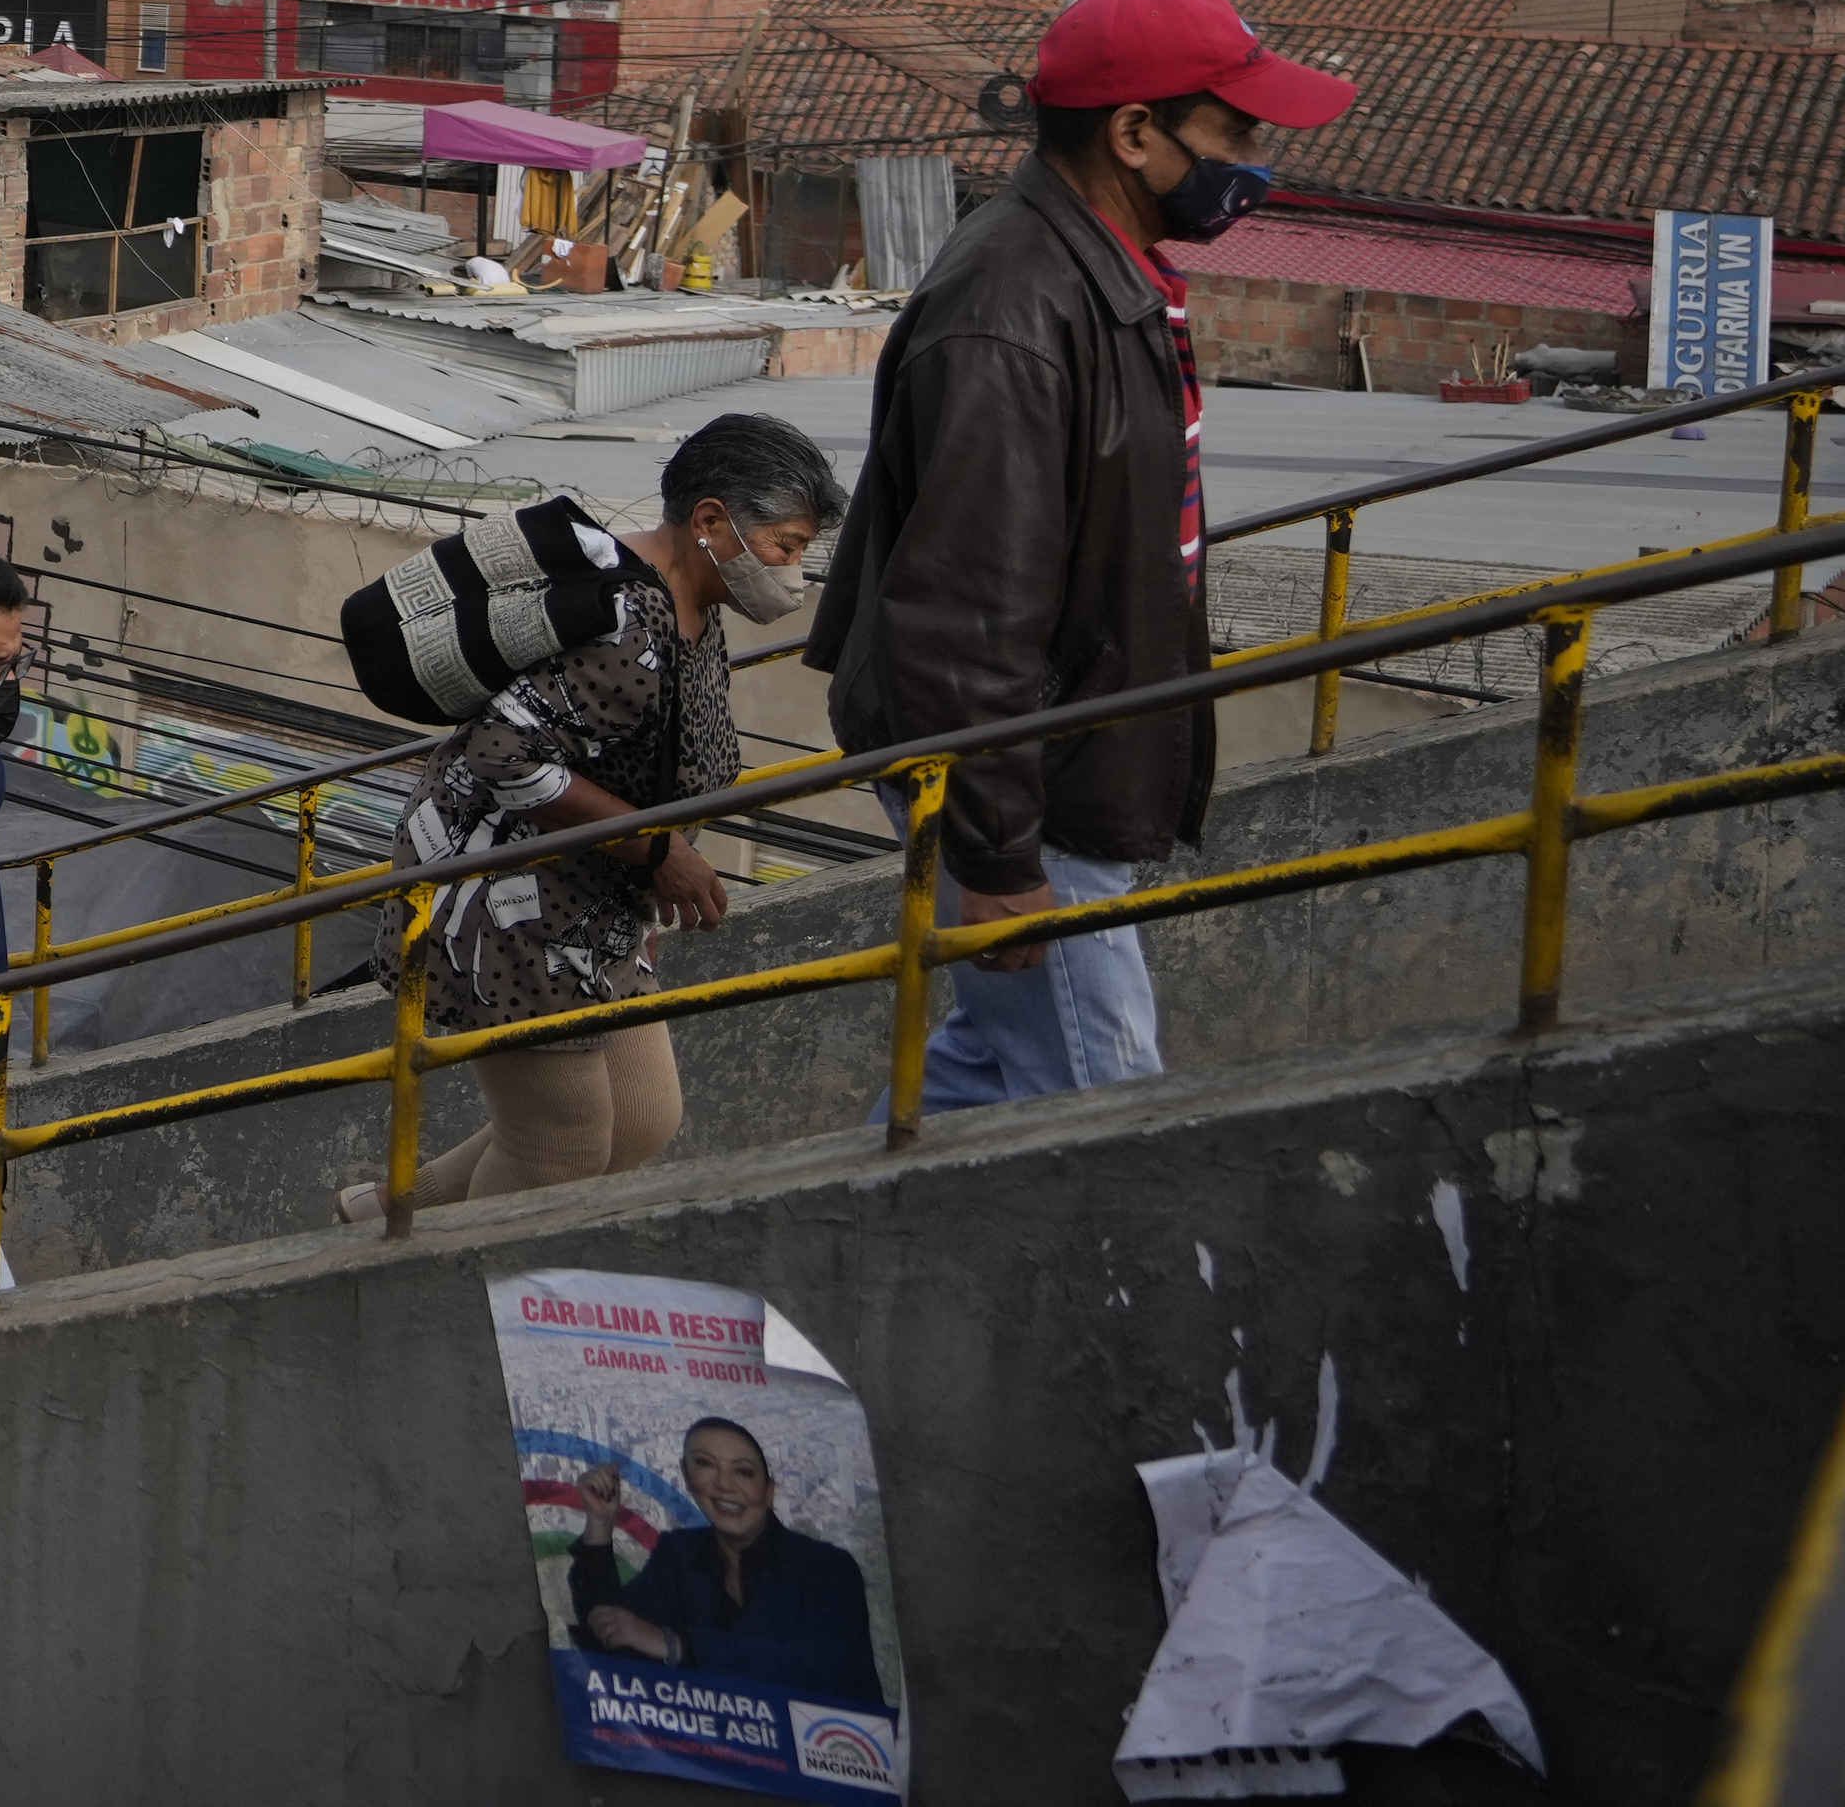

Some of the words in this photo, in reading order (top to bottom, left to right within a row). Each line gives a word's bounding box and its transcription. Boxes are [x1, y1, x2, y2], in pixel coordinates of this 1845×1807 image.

[520, 1296, 662, 1335] CAROLINA
[668, 1311, 765, 1346] RESTR
[583, 1345, 668, 1374] CÁMARA
[587, 1669, 606, 1693] A
[612, 1672, 648, 1700] LA
[654, 1680, 775, 1723] CÁMARA
[590, 1697, 718, 1738] ¡MARQUE
[725, 1719, 779, 1749] ASÍ!
[806, 1756, 894, 1786] NACIONAL
